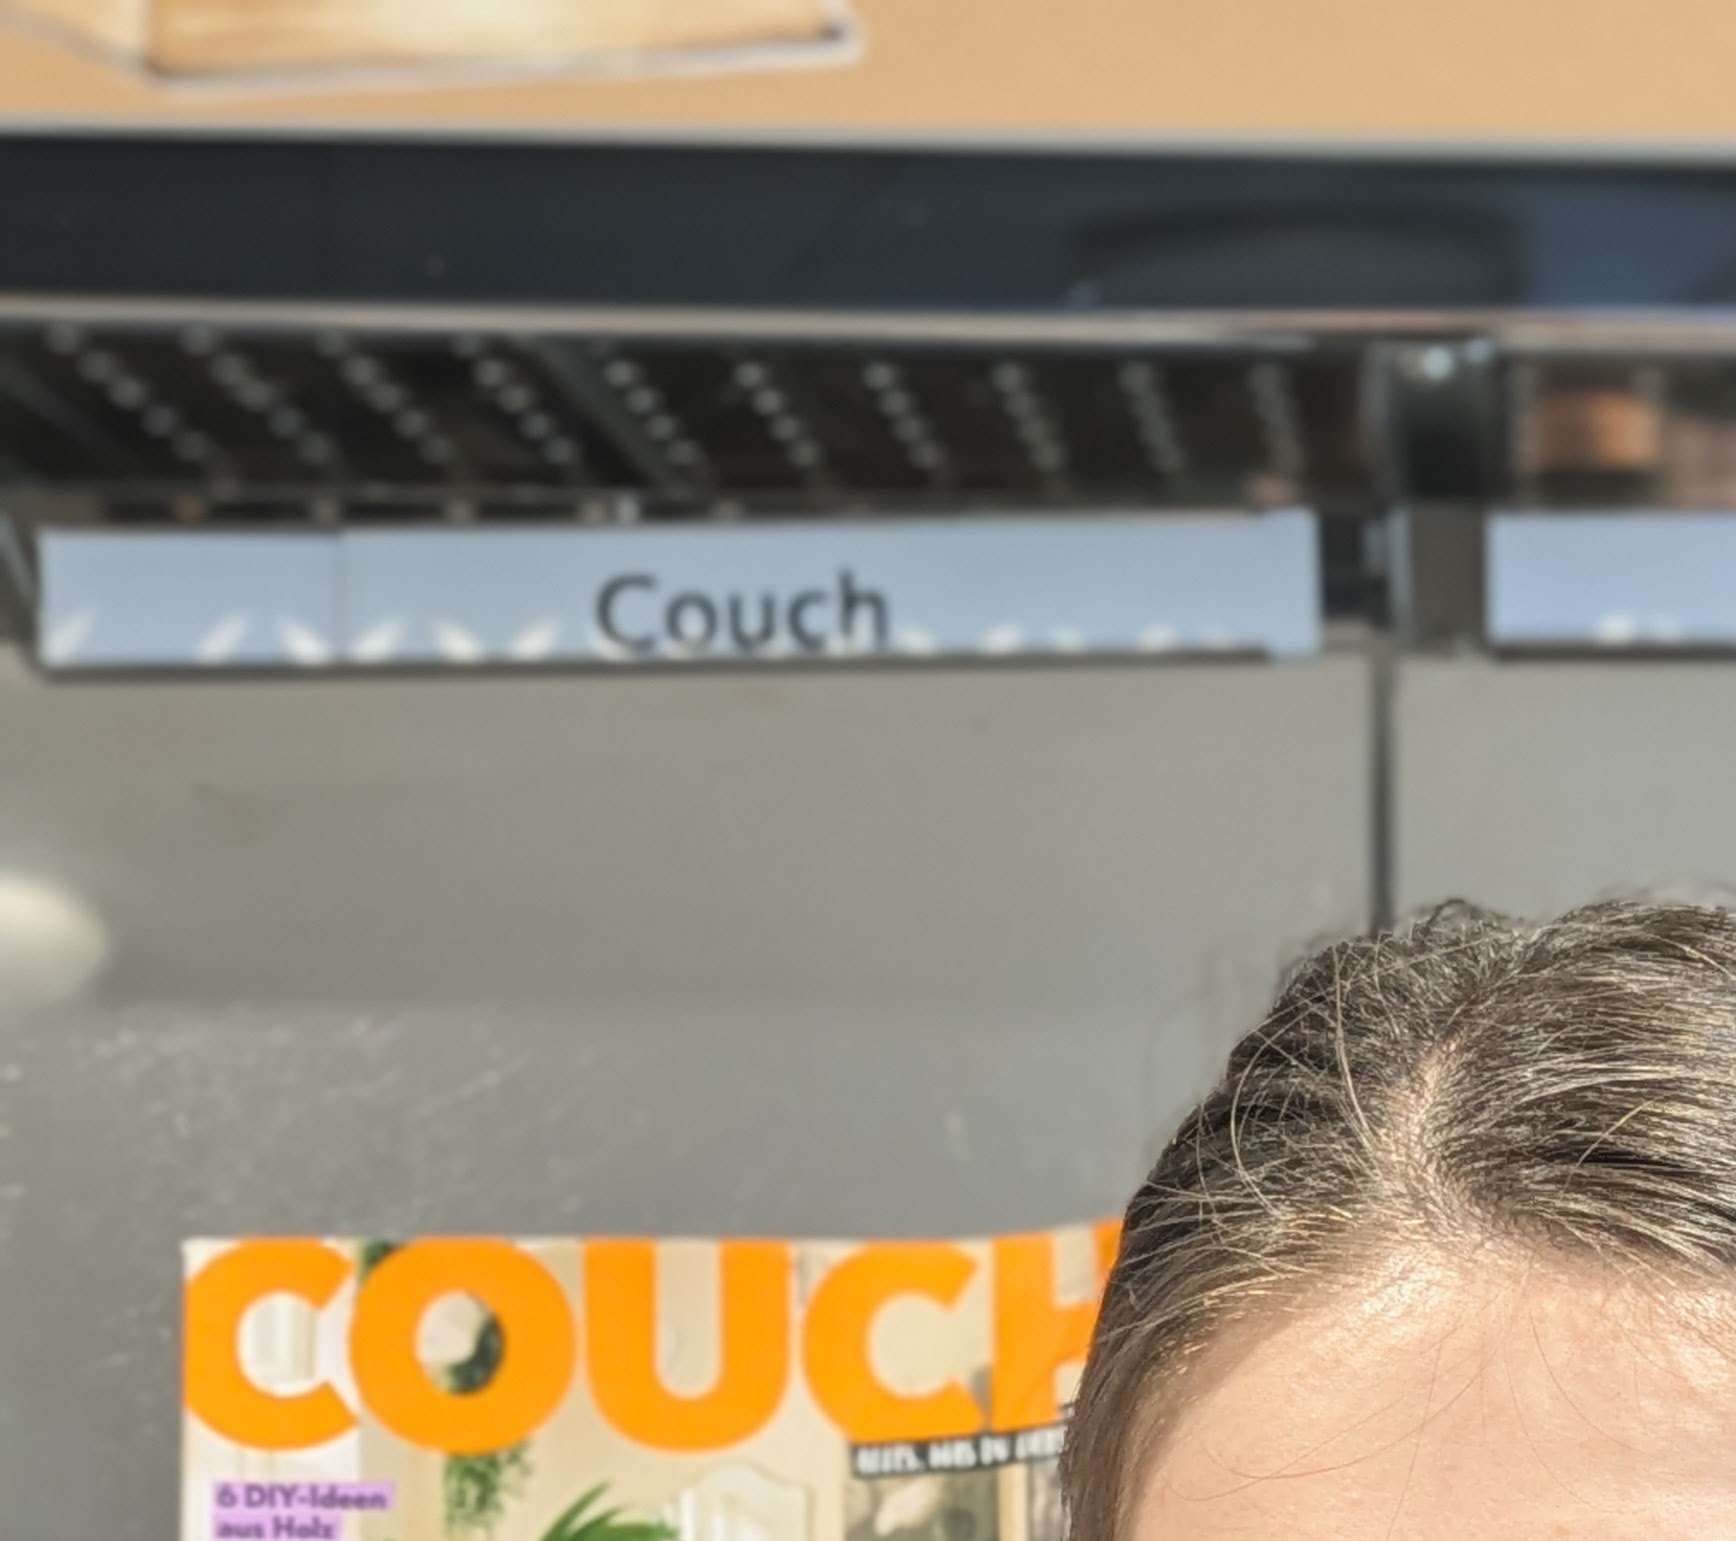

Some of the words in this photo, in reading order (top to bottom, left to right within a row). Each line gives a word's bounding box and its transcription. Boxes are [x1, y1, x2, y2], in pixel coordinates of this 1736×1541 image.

[595, 564, 889, 655] Couch
[216, 1482, 237, 1508] 6
[244, 1482, 388, 1509] DIY-Ideen
[216, 1523, 265, 1539] aus
[272, 1515, 334, 1540] Holz
